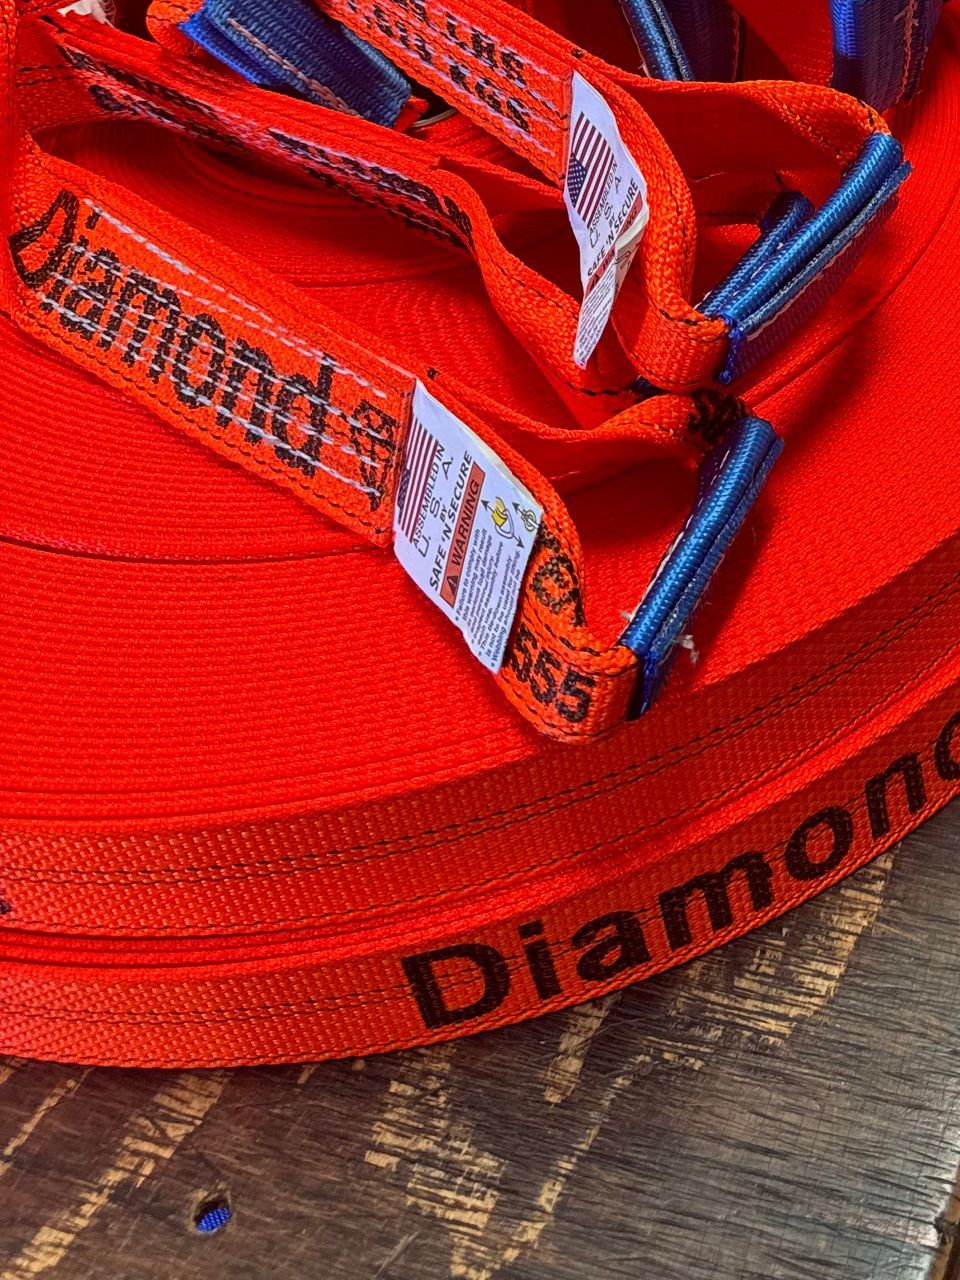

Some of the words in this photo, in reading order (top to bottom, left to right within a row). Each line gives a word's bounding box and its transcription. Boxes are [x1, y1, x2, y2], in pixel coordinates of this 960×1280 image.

[587, 250, 607, 277] SAFE
[615, 177, 639, 230] SECURE
[589, 172, 614, 235] ASSEMBLED
[609, 213, 616, 228] BY
[7, 189, 337, 478] Diamond
[411, 458, 440, 551] ASSEMBLED
[433, 439, 445, 463] IN
[417, 527, 431, 561] U.
[428, 487, 443, 522] S.
[439, 447, 454, 483] A.
[428, 542, 446, 592] SAFE
[446, 448, 473, 524] SECURE
[438, 502, 448, 523] BY
[450, 475, 480, 569] WARNING
[465, 545, 477, 580] comply
[471, 525, 480, 548] with
[465, 570, 478, 606] warning
[491, 623, 507, 665] Webbing
